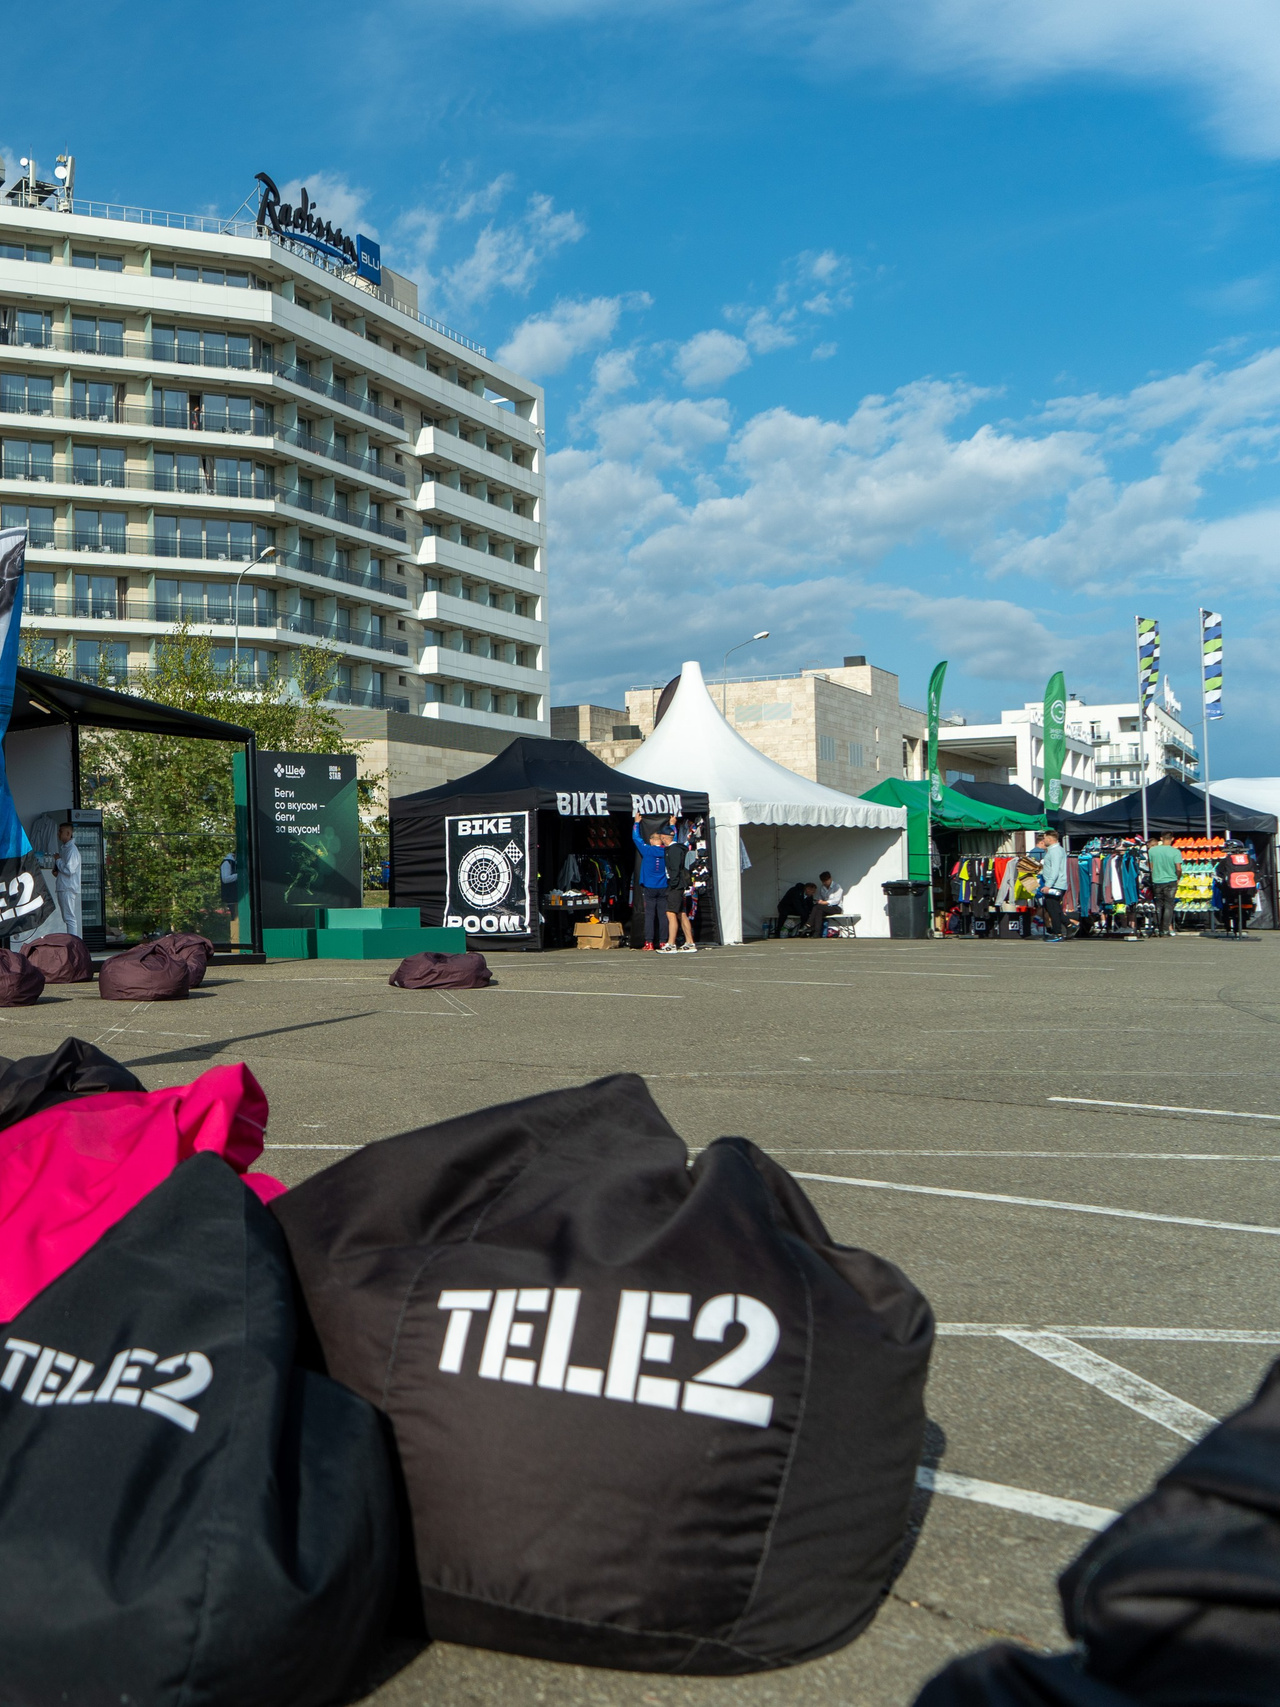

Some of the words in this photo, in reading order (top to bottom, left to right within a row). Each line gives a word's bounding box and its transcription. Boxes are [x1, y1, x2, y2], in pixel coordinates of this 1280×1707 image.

[254, 172, 359, 262] Radisson
[361, 251, 380, 271] BLU
[285, 764, 306, 778] Шеф
[328, 772, 342, 780] STAR
[274, 787, 295, 798] Беги
[274, 802, 286, 810] со
[287, 802, 318, 812] вкусом
[556, 792, 610, 816] BIKE
[631, 793, 683, 818] ROOM
[275, 812, 295, 821] беги
[287, 824, 320, 835] вкусом!
[457, 818, 512, 836] BIKE
[437, 1288, 780, 1428] TELE2
[0, 1337, 213, 1433] TELE2
